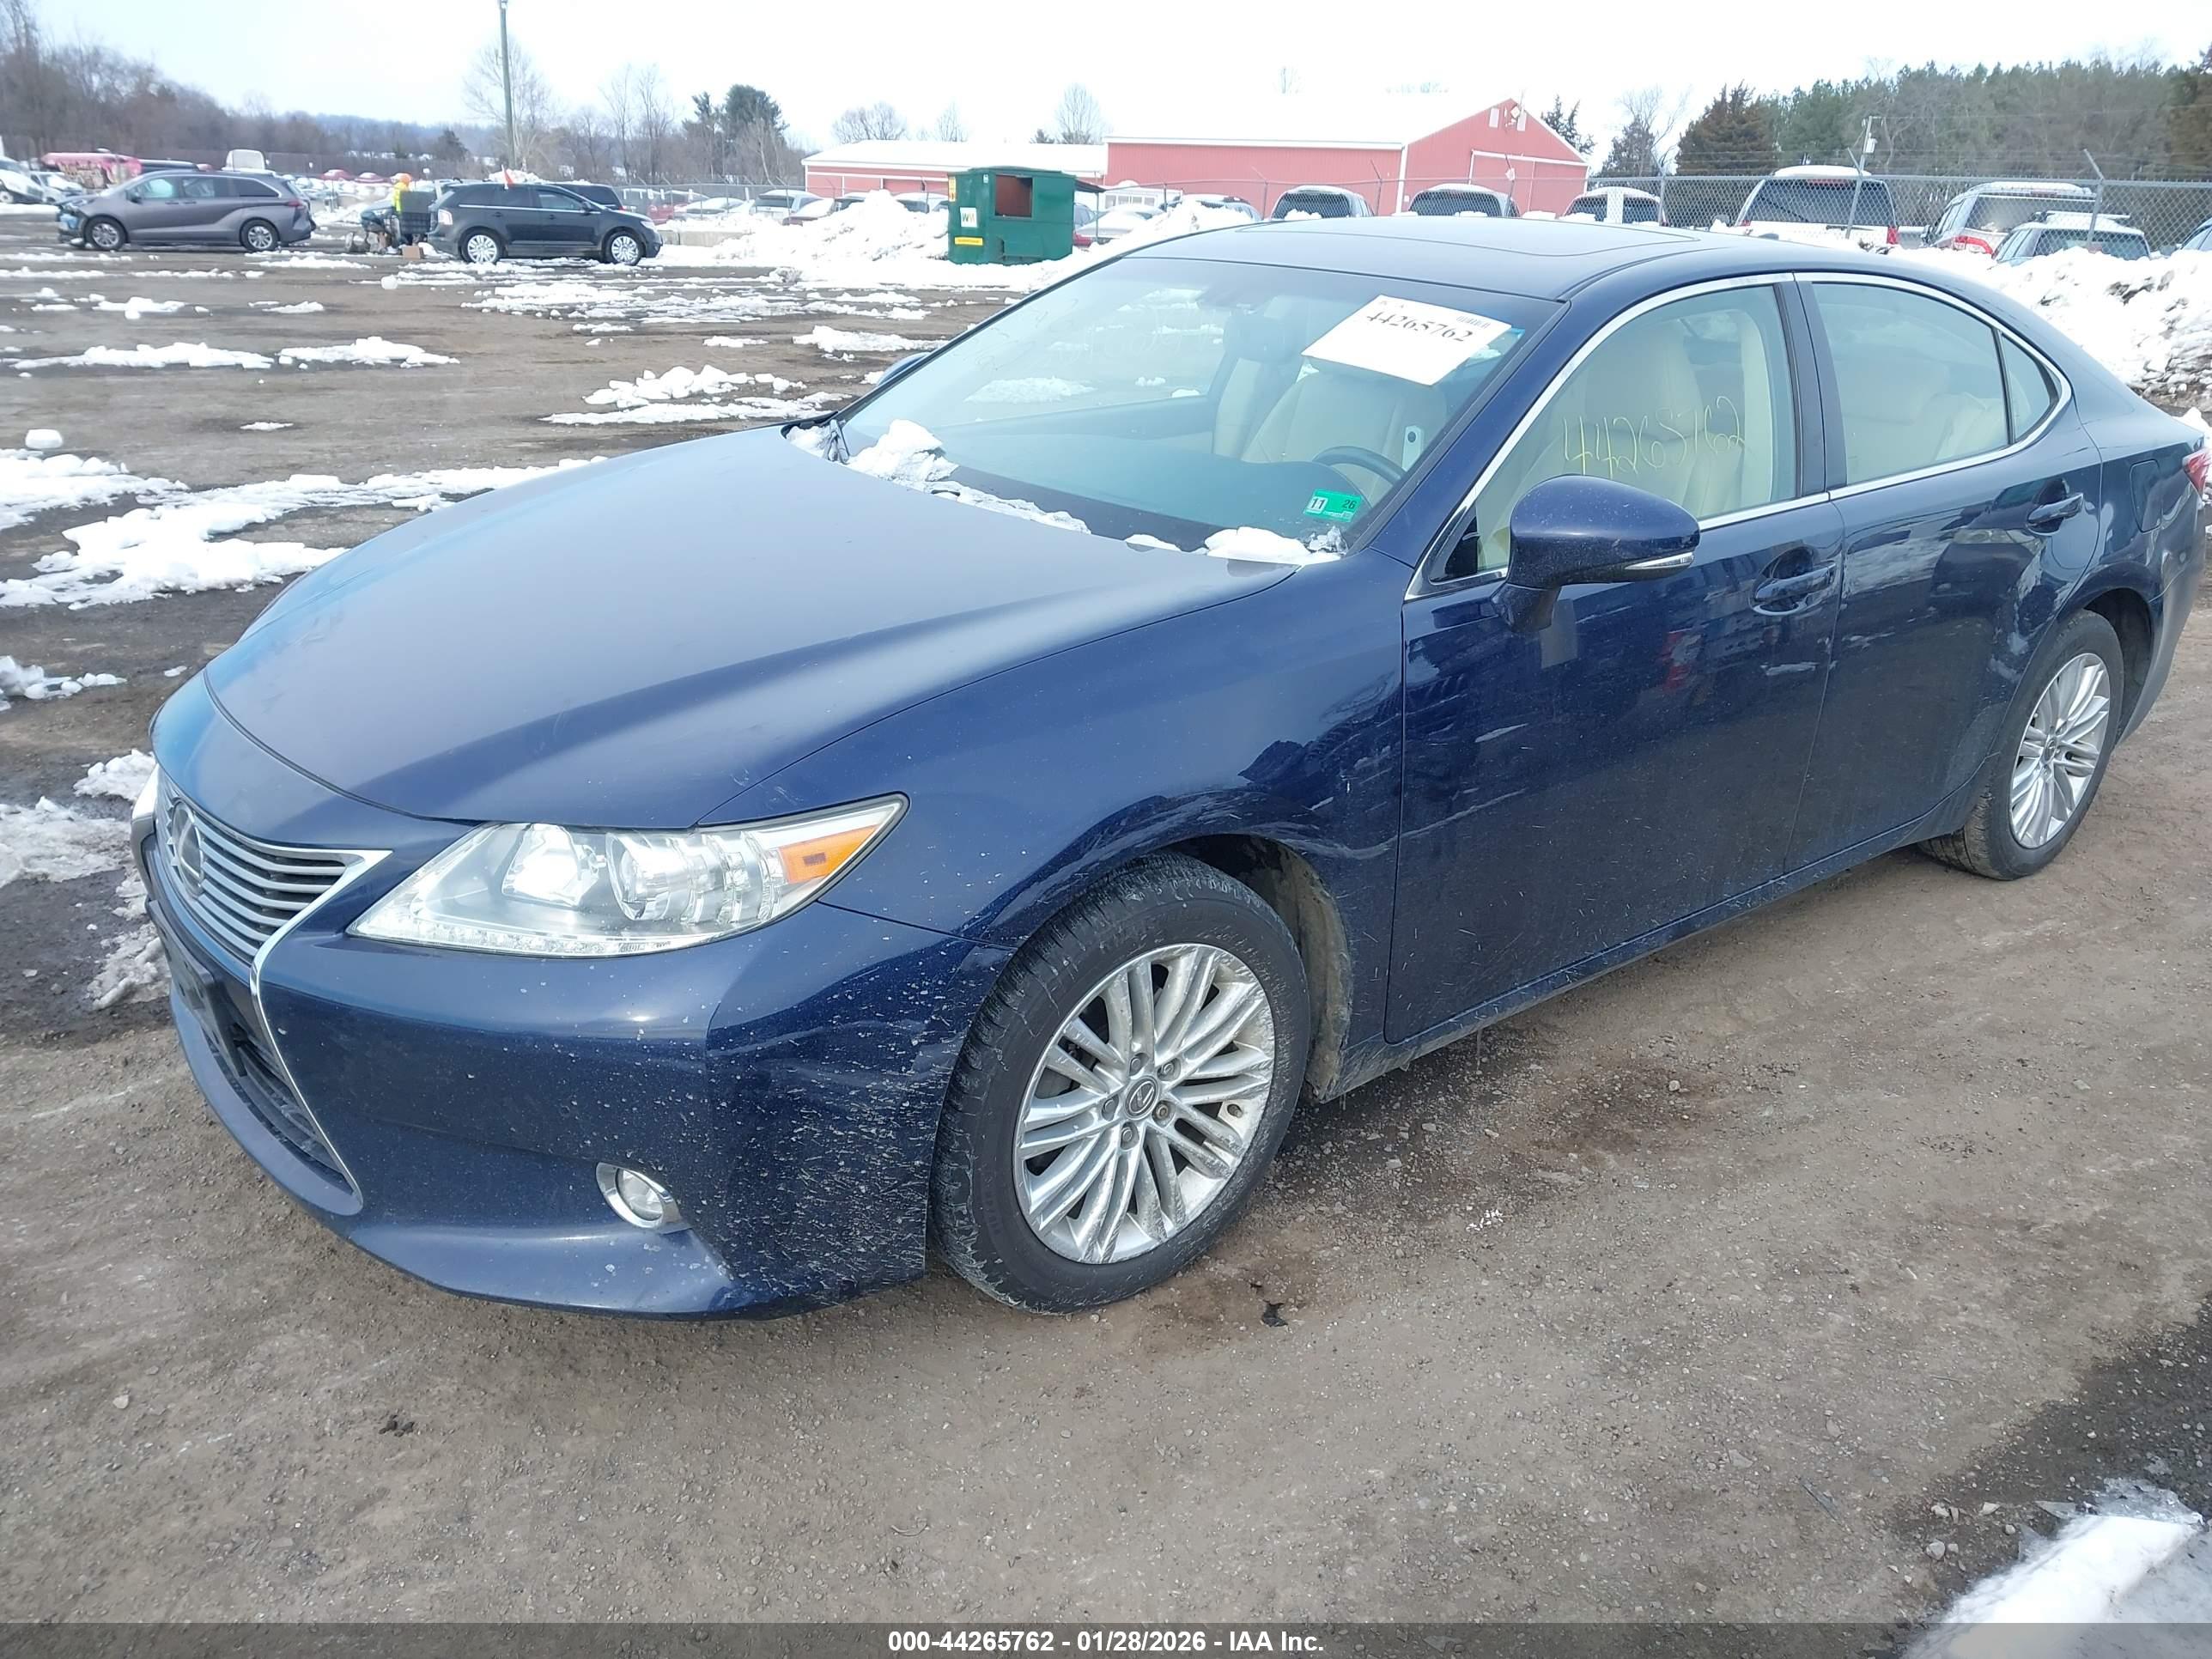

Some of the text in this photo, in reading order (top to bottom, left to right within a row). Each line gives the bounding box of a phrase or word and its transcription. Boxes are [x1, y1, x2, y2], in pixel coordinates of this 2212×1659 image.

[1366, 311, 1474, 342] 44265762
[1311, 497, 1358, 509] 11 26
